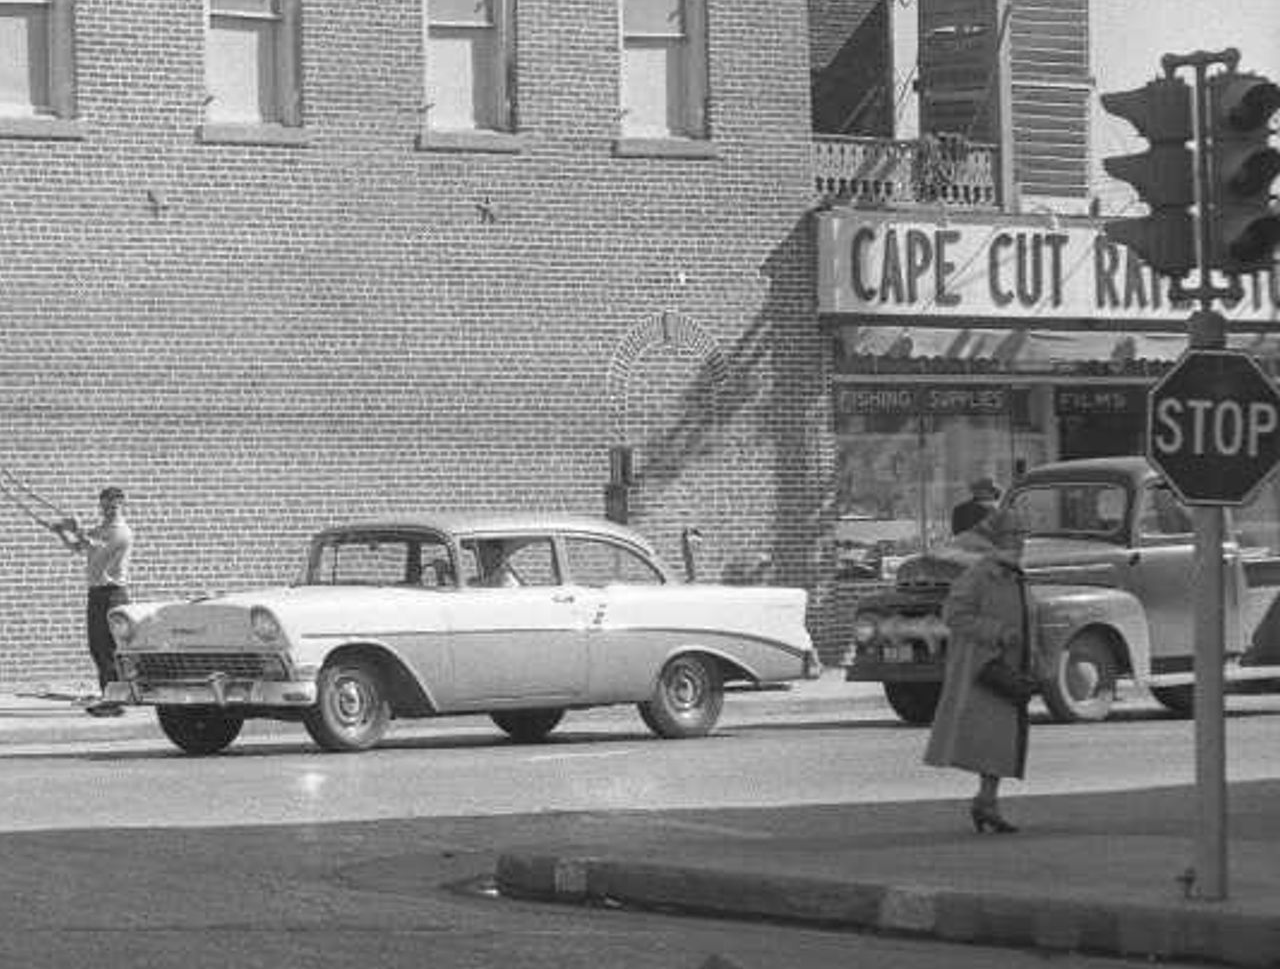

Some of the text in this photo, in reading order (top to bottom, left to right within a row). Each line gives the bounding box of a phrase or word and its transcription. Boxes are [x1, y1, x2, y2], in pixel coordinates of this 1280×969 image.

[851, 227, 961, 307] CAPE
[989, 232, 1069, 309] CUT
[1156, 397, 1278, 458] STOP
